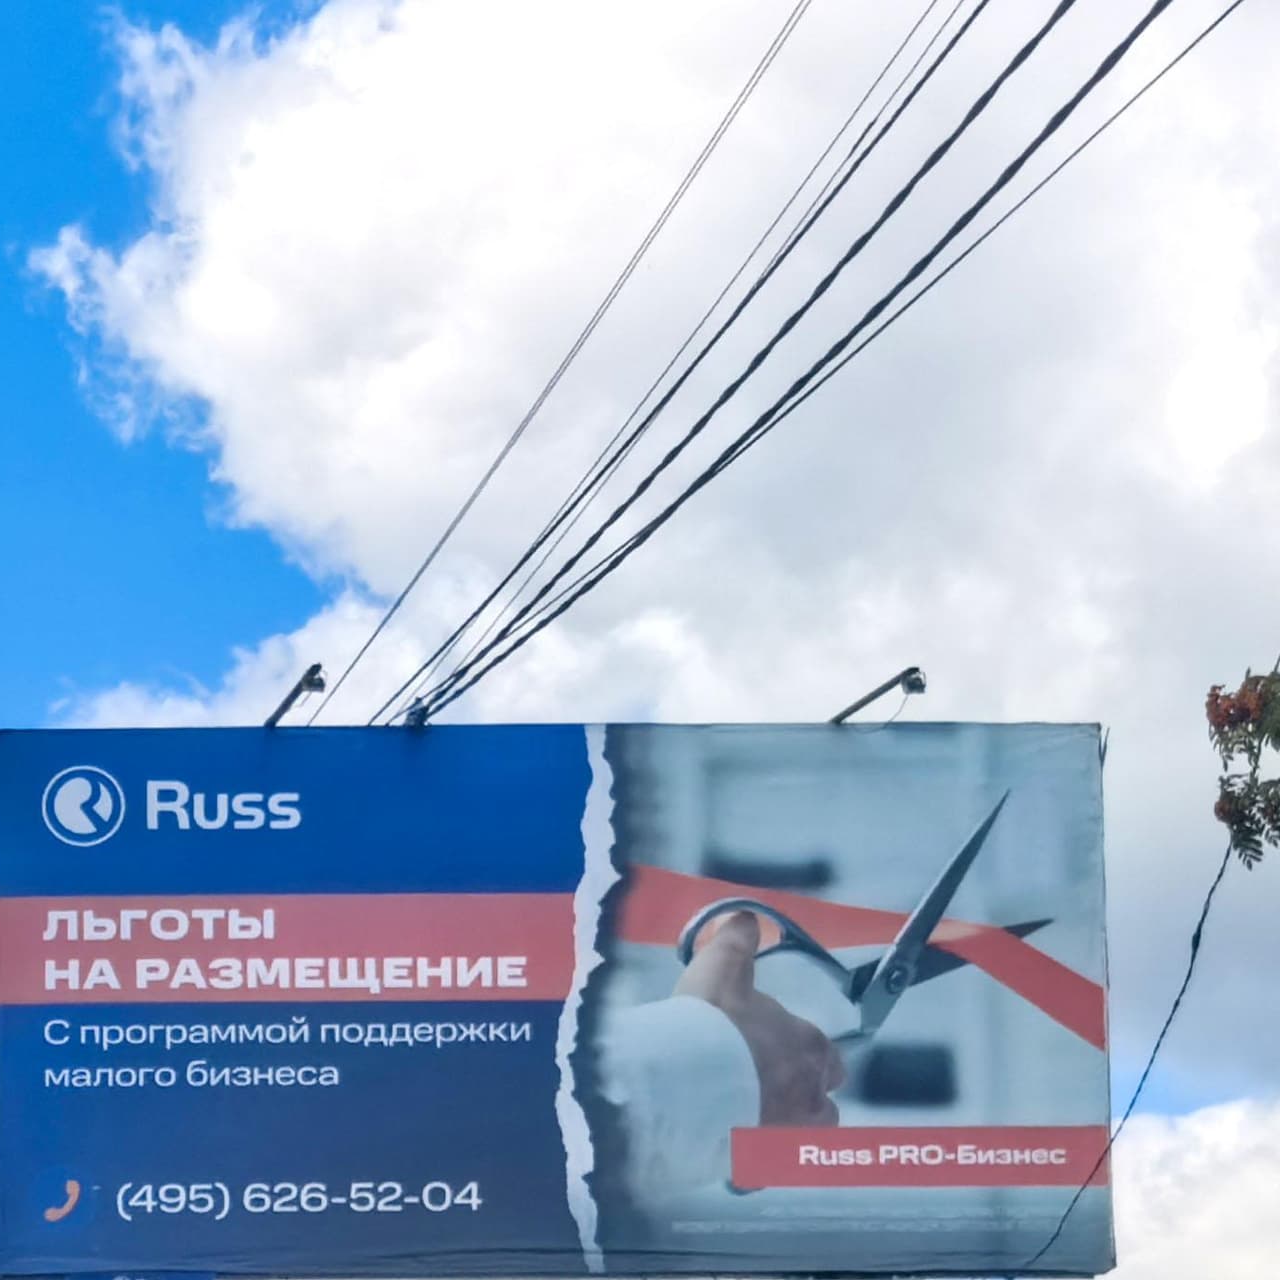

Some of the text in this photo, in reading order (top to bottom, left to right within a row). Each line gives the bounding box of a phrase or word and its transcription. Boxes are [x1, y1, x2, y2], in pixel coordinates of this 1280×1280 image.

[146, 780, 301, 830] Russ
[43, 909, 275, 941] ЛЬГОТЫ
[44, 957, 528, 994] НА РАЗМЕЩЕНИЕ
[44, 1017, 531, 1051] С программой поддержки
[44, 1061, 339, 1088] малого бизнеса
[799, 1144, 1066, 1166] Russ PRO-Бизнес
[116, 1182, 483, 1221] (495) 626-52-04
